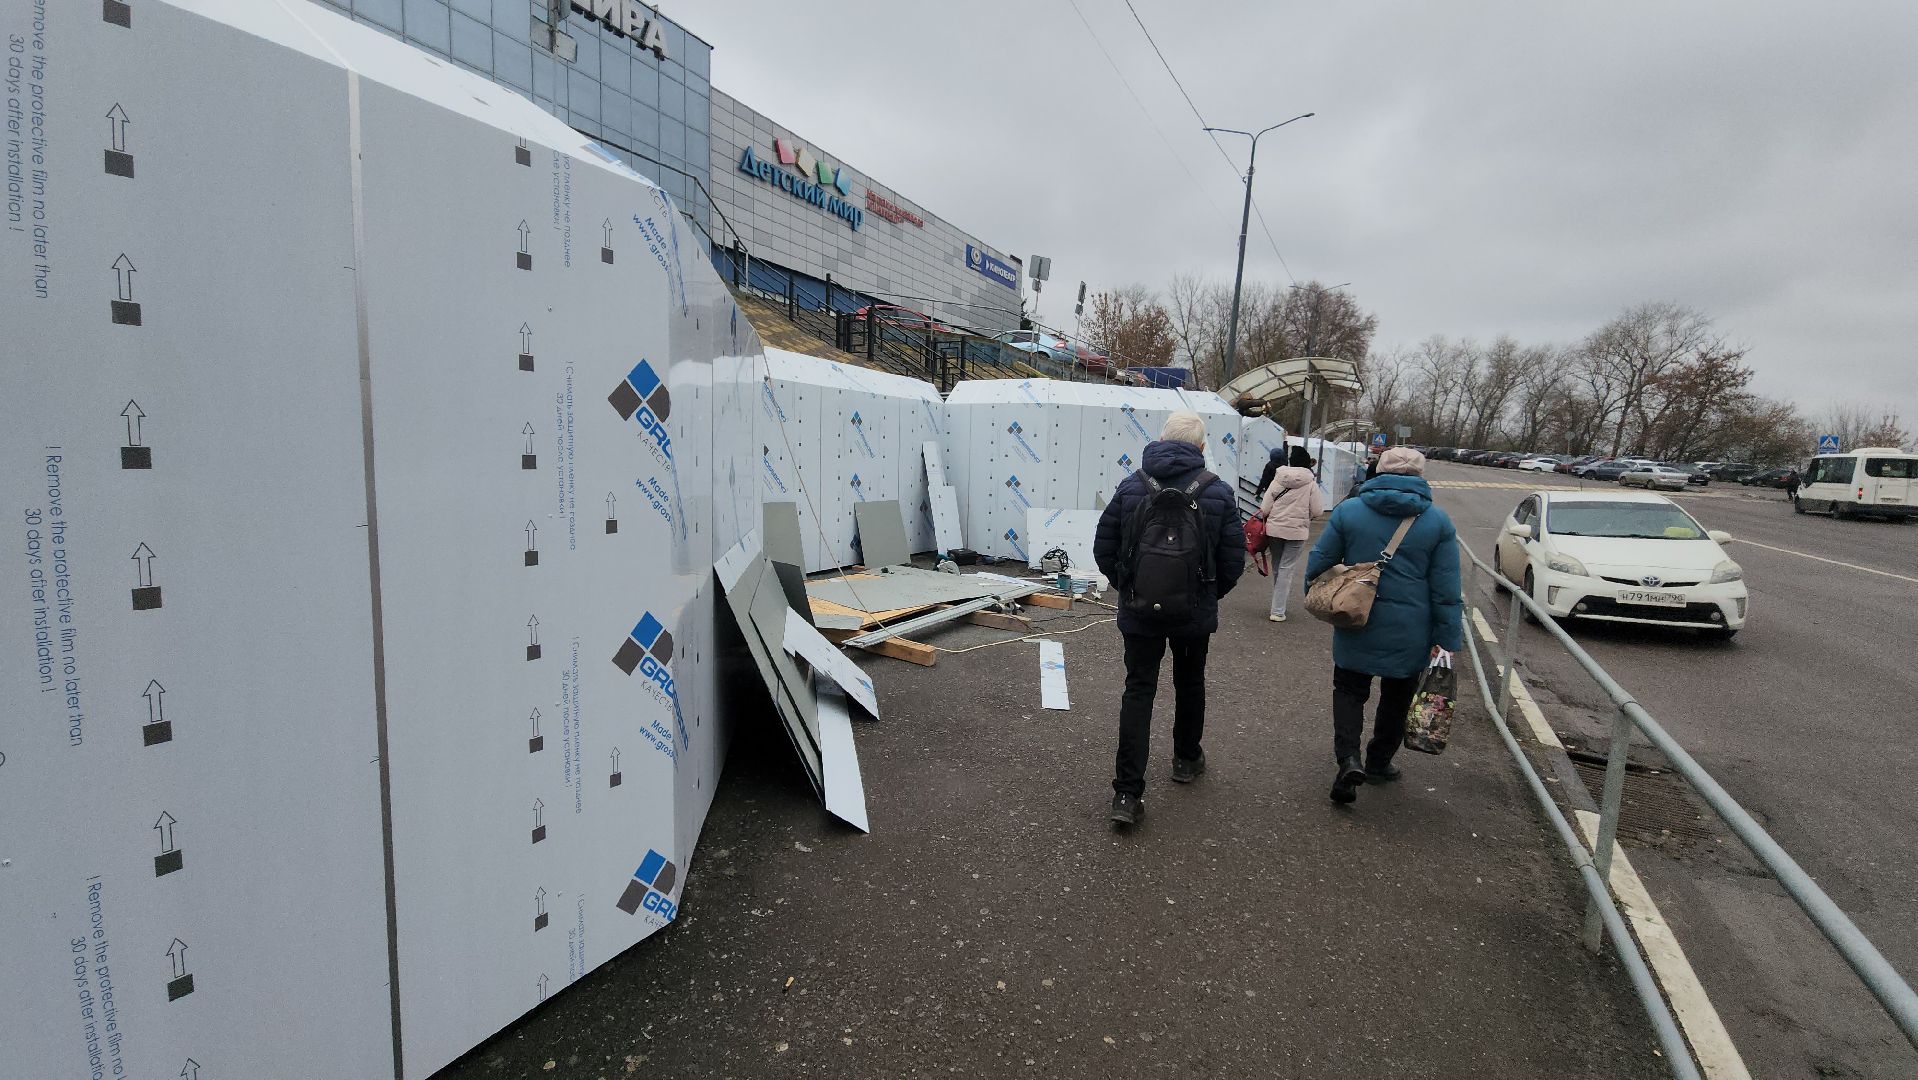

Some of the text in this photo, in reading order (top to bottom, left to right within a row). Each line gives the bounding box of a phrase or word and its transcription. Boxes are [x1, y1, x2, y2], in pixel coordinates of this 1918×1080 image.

[9, 33, 25, 52] 30
[571, 0, 670, 58] ИРА
[5, 57, 25, 93] days
[31, 55, 46, 80] the
[7, 98, 25, 137] after
[29, 82, 46, 165] protective
[8, 139, 25, 223] installation
[32, 170, 48, 195] film
[739, 145, 827, 209] Детский
[827, 195, 864, 232] мир
[33, 200, 46, 220] no
[33, 225, 48, 260] later
[645, 217, 666, 249] Made
[34, 264, 51, 299] than
[46, 455, 62, 517] Remove
[648, 476, 669, 503] Made
[25, 508, 42, 526] 30
[51, 520, 67, 545] the
[26, 530, 42, 566] days
[30, 569, 47, 604] after
[54, 550, 71, 624] protective
[33, 608, 54, 684] installation
[60, 628, 77, 653] film
[63, 656, 76, 675] no
[65, 679, 80, 710] later
[69, 714, 83, 747] than
[651, 720, 672, 740] Made
[87, 882, 105, 940] Remove
[71, 936, 86, 953] 30
[95, 940, 109, 963] the
[73, 956, 89, 988] days
[79, 989, 95, 1021] after
[95, 965, 119, 1032] protective
[106, 1032, 122, 1056] film
[112, 1057, 123, 1075] no
